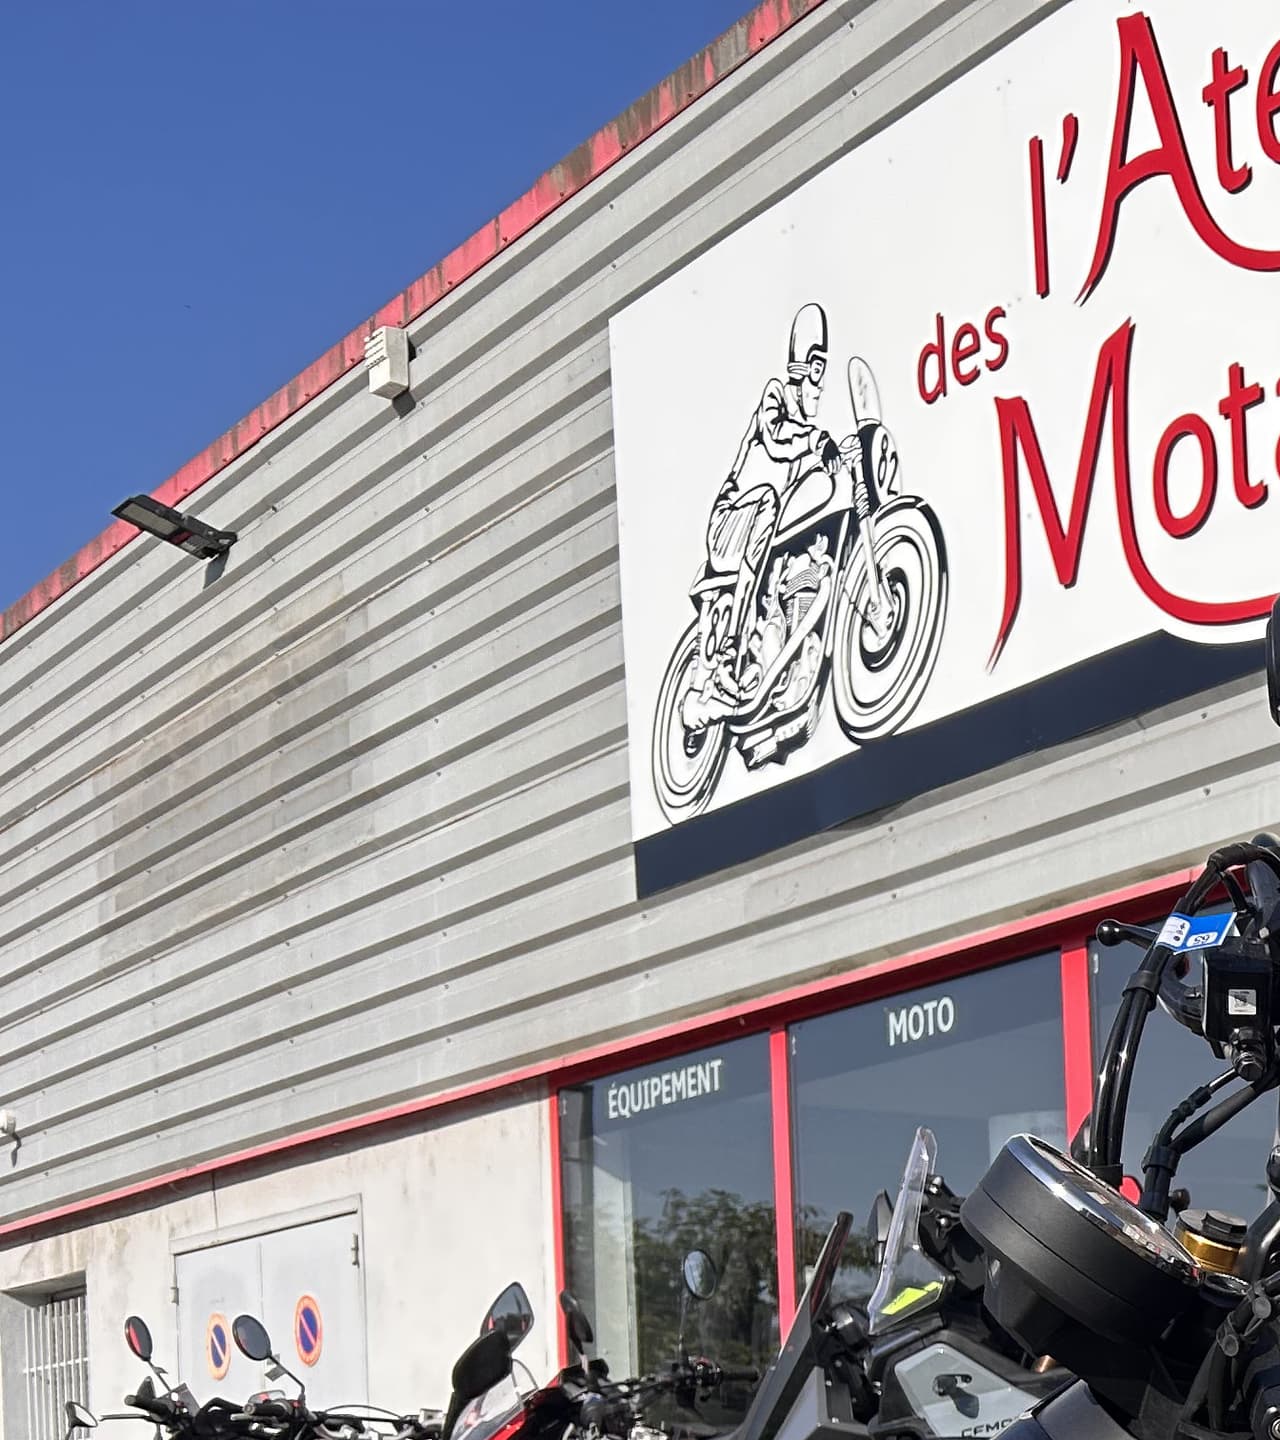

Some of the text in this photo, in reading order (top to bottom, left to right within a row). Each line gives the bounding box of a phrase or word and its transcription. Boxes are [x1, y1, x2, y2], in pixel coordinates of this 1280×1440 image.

[916, 304, 1010, 403] des
[888, 996, 955, 1047] MOTO
[607, 1059, 723, 1120] ÉQUIPEMENT
